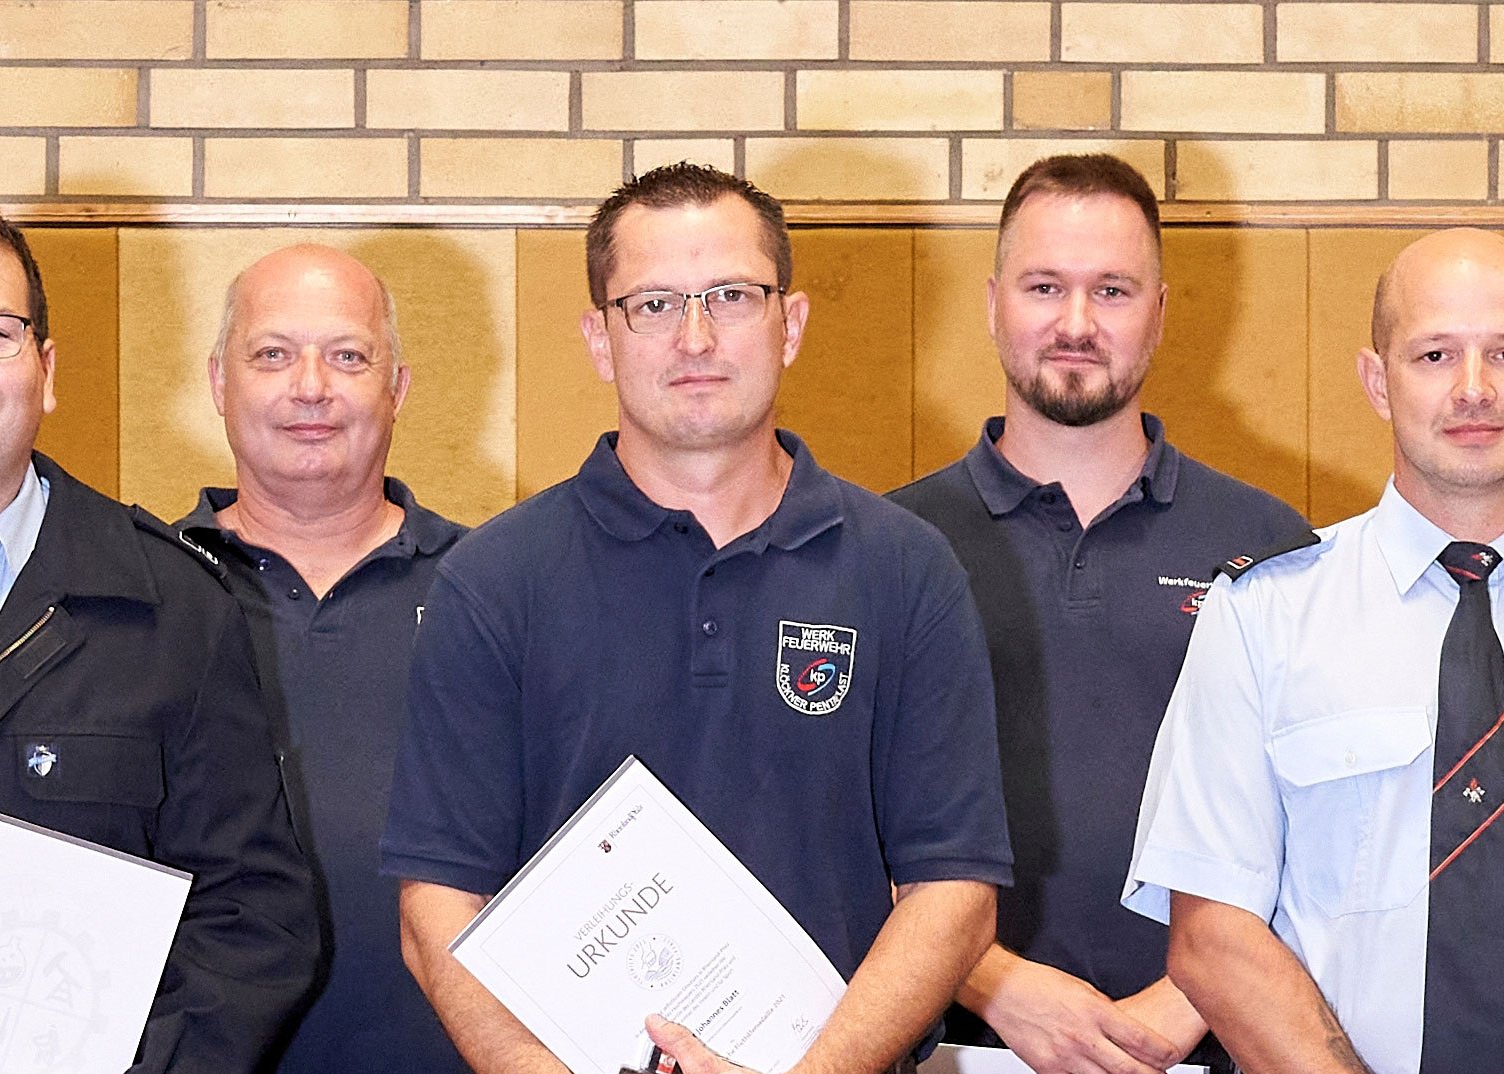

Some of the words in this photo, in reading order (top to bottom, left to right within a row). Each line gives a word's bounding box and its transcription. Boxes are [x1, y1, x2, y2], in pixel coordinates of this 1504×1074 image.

[782, 635, 851, 656] FEUERWEHR
[801, 627, 836, 642] WERK
[810, 669, 826, 686] kp
[574, 881, 634, 941] VERLEIHUNGS-
[566, 872, 674, 979] URKUNDE
[695, 1005, 725, 1036] Johannes
